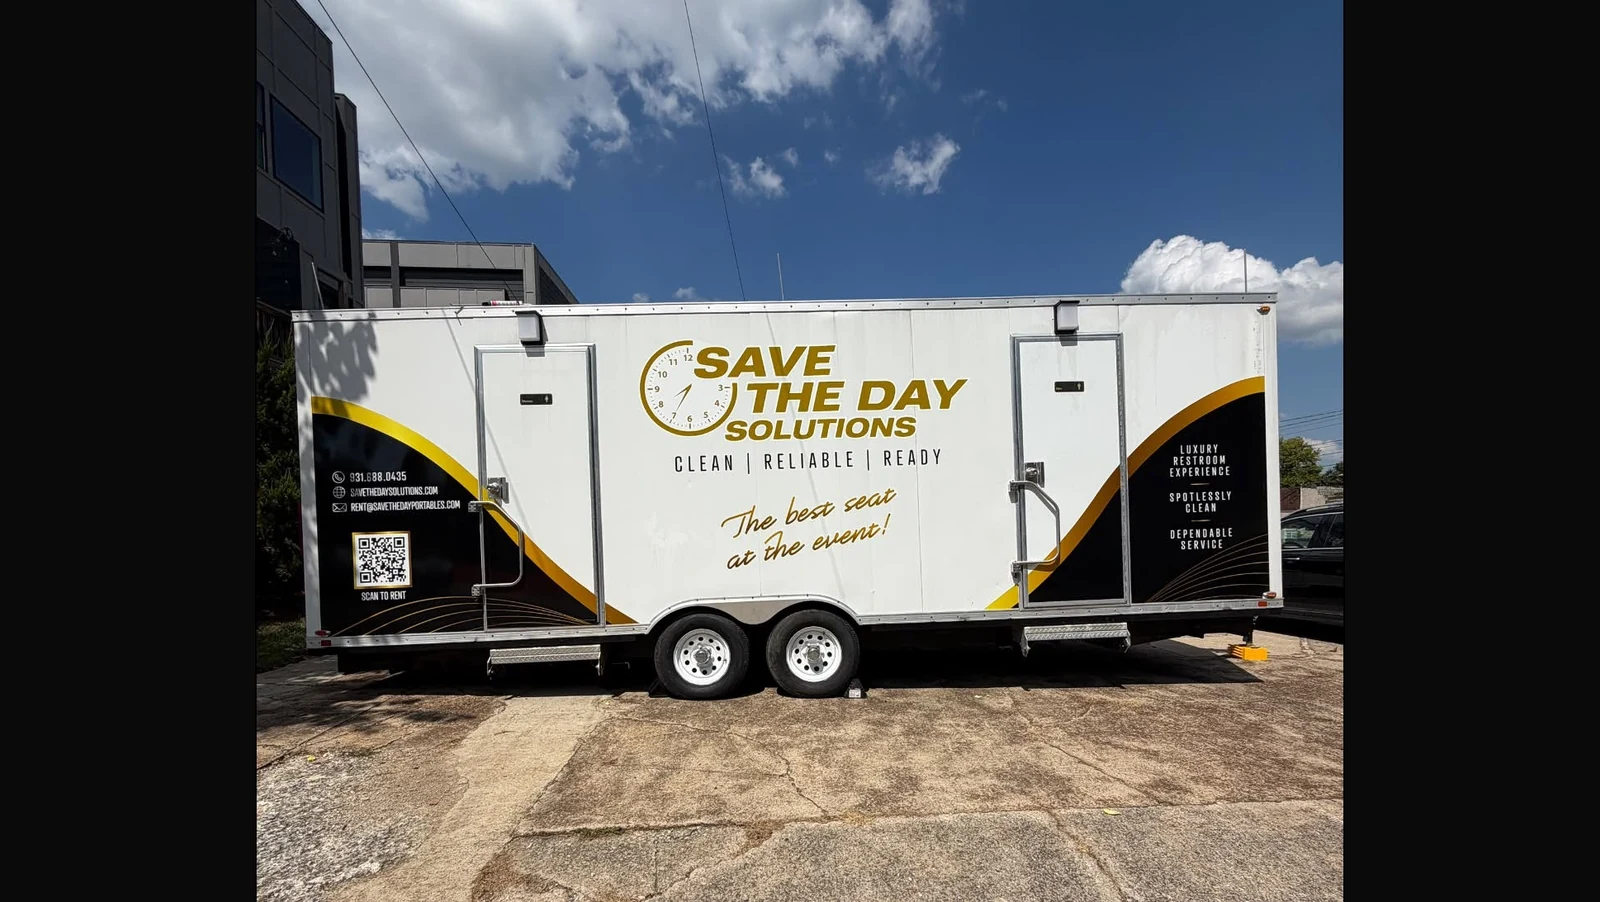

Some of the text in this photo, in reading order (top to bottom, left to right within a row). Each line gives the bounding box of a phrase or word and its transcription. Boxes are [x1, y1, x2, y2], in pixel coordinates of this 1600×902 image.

[683, 354, 693, 362] 12
[693, 345, 836, 379] SAVE
[747, 378, 969, 414] THE DAY
[725, 417, 917, 441] SOLUTIONS
[1180, 444, 1218, 454] LUXURY
[674, 454, 734, 473] CLEAN
[763, 450, 854, 470] RELIABLE
[883, 448, 942, 467] READY
[1173, 455, 1226, 466] RESTROOM
[350, 471, 407, 482] 931.688.0435
[1169, 466, 1230, 478] EXPERIENCE
[350, 486, 438, 497] SAVETHEDAYSOLUTIONS.COM
[1169, 491, 1231, 502] SPOTLESSLY
[350, 500, 460, 512] RENT@SAVETHEDAYPORTABLES.COM
[1185, 503, 1217, 513] CLEAN
[721, 488, 897, 539] The best seat
[1170, 528, 1233, 539] DEPENDABLE
[726, 513, 891, 570] at the event!
[1180, 539, 1223, 550] SERVICE
[361, 590, 407, 600] SCAN TO RENT
